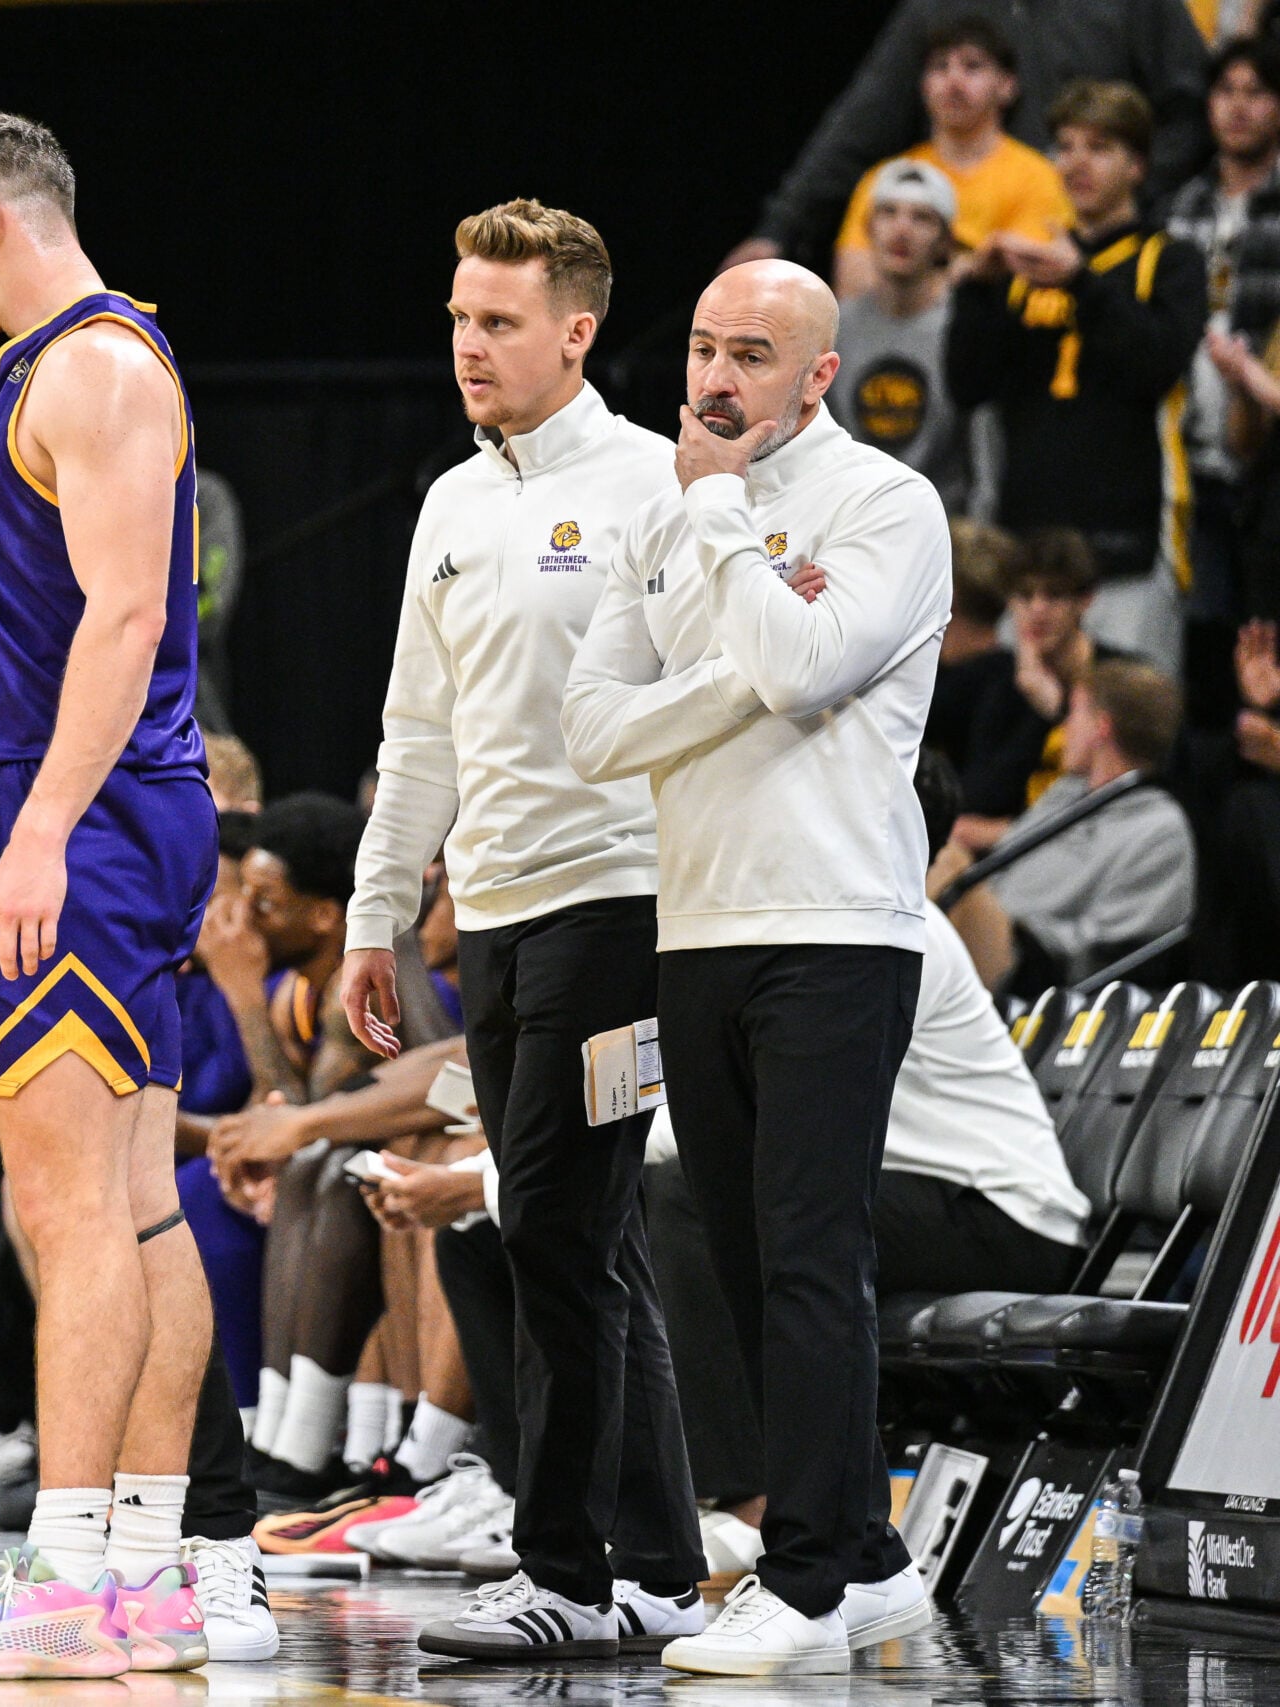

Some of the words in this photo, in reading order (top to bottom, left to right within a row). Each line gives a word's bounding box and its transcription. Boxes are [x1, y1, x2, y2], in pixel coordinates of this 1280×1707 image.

[537, 555, 588, 564] LEATHERNECK
[1030, 1483, 1085, 1520] Bankers
[1224, 1494, 1267, 1512] DAKTRONICS
[1014, 1520, 1055, 1557] Trust
[1206, 1534, 1255, 1568] MidWestOne
[1207, 1569, 1228, 1599] Bank
